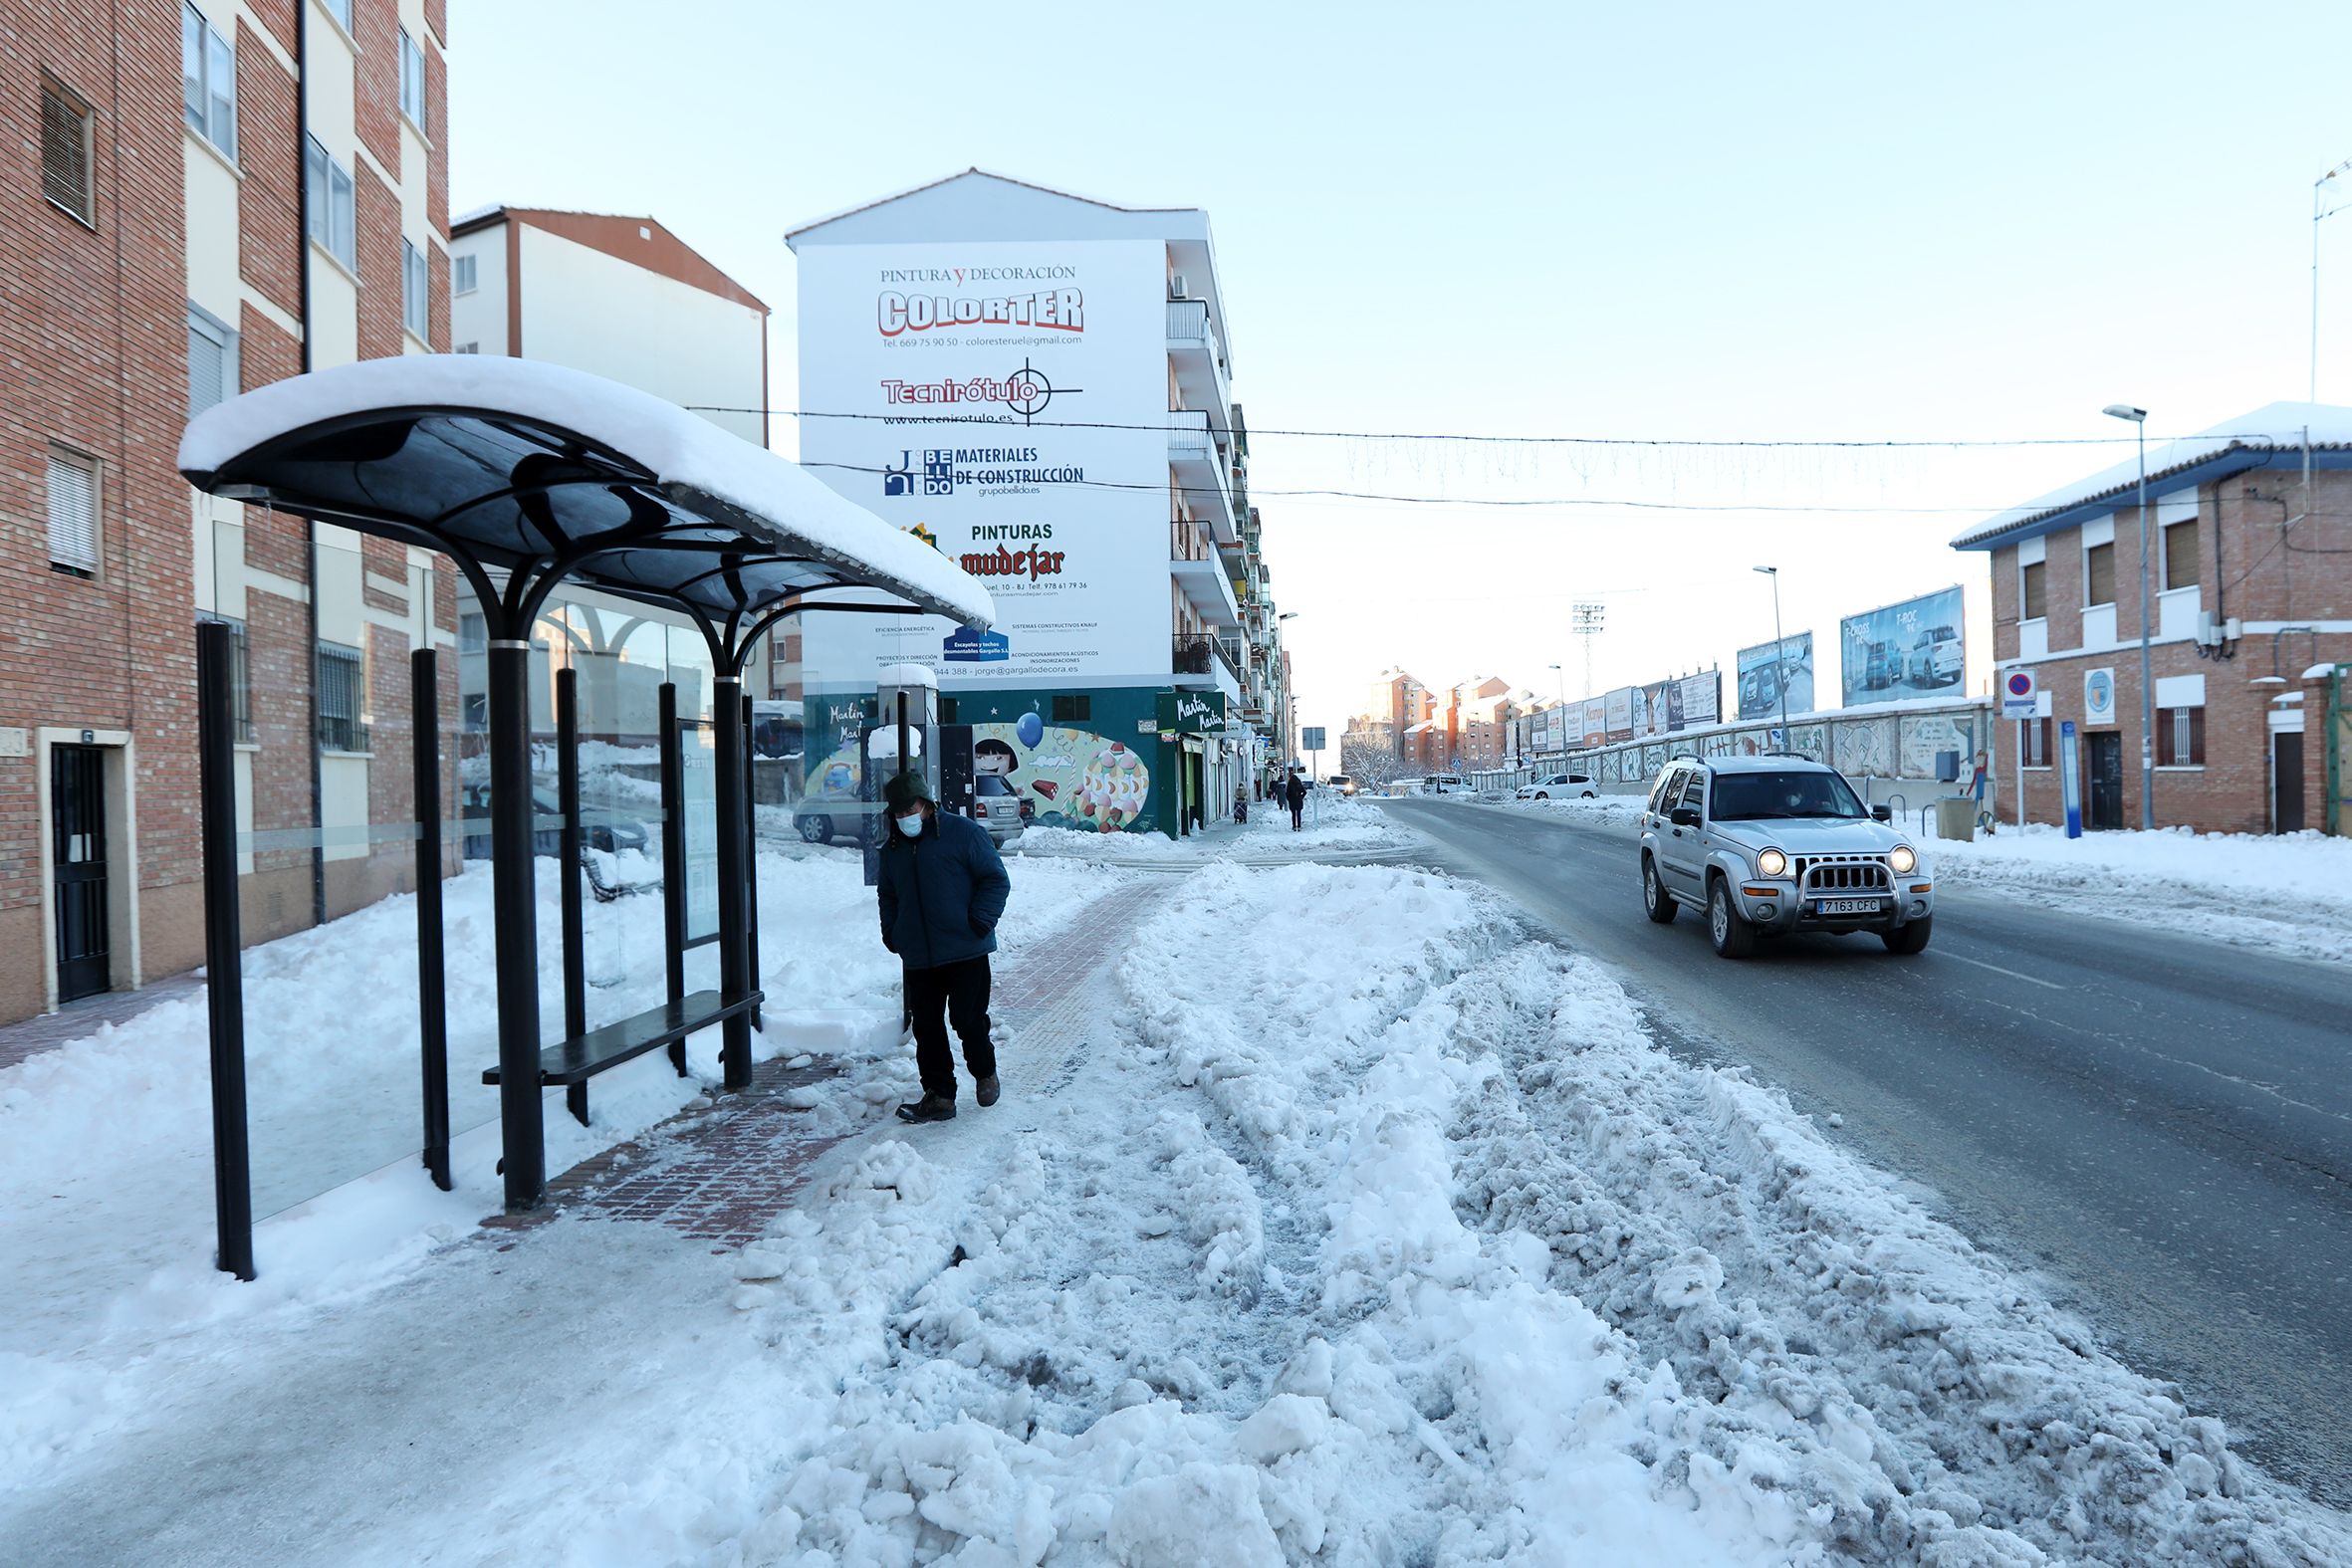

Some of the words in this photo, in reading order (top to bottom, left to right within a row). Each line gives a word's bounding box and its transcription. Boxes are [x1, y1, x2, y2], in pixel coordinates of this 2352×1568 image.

[880, 269, 952, 283] PINTURA
[953, 268, 967, 288] y
[970, 263, 1075, 281] DECORACIÓN
[878, 287, 1084, 336] COLORTER
[899, 338, 917, 347] 669
[919, 338, 931, 347] 75
[932, 337, 945, 347] 90
[946, 337, 959, 346] 50
[965, 335, 1082, 347] coloresteruel@gmail.com
[881, 377, 1039, 404] Tecnirótulo
[883, 413, 1014, 425] www.tecnirotulo.es
[955, 448, 1038, 463] MATERIALES
[956, 471, 973, 485] DE
[977, 464, 1084, 485] CONSTRUCCIÓN
[978, 485, 1041, 497] grupobellido.es
[972, 524, 1053, 541] PINTURAS
[960, 543, 1065, 582] mudejar
[974, 665, 1078, 678] jorge@gargallodecora.es
[1825, 901, 1853, 912] 7163
[1856, 900, 1877, 911] CFC
